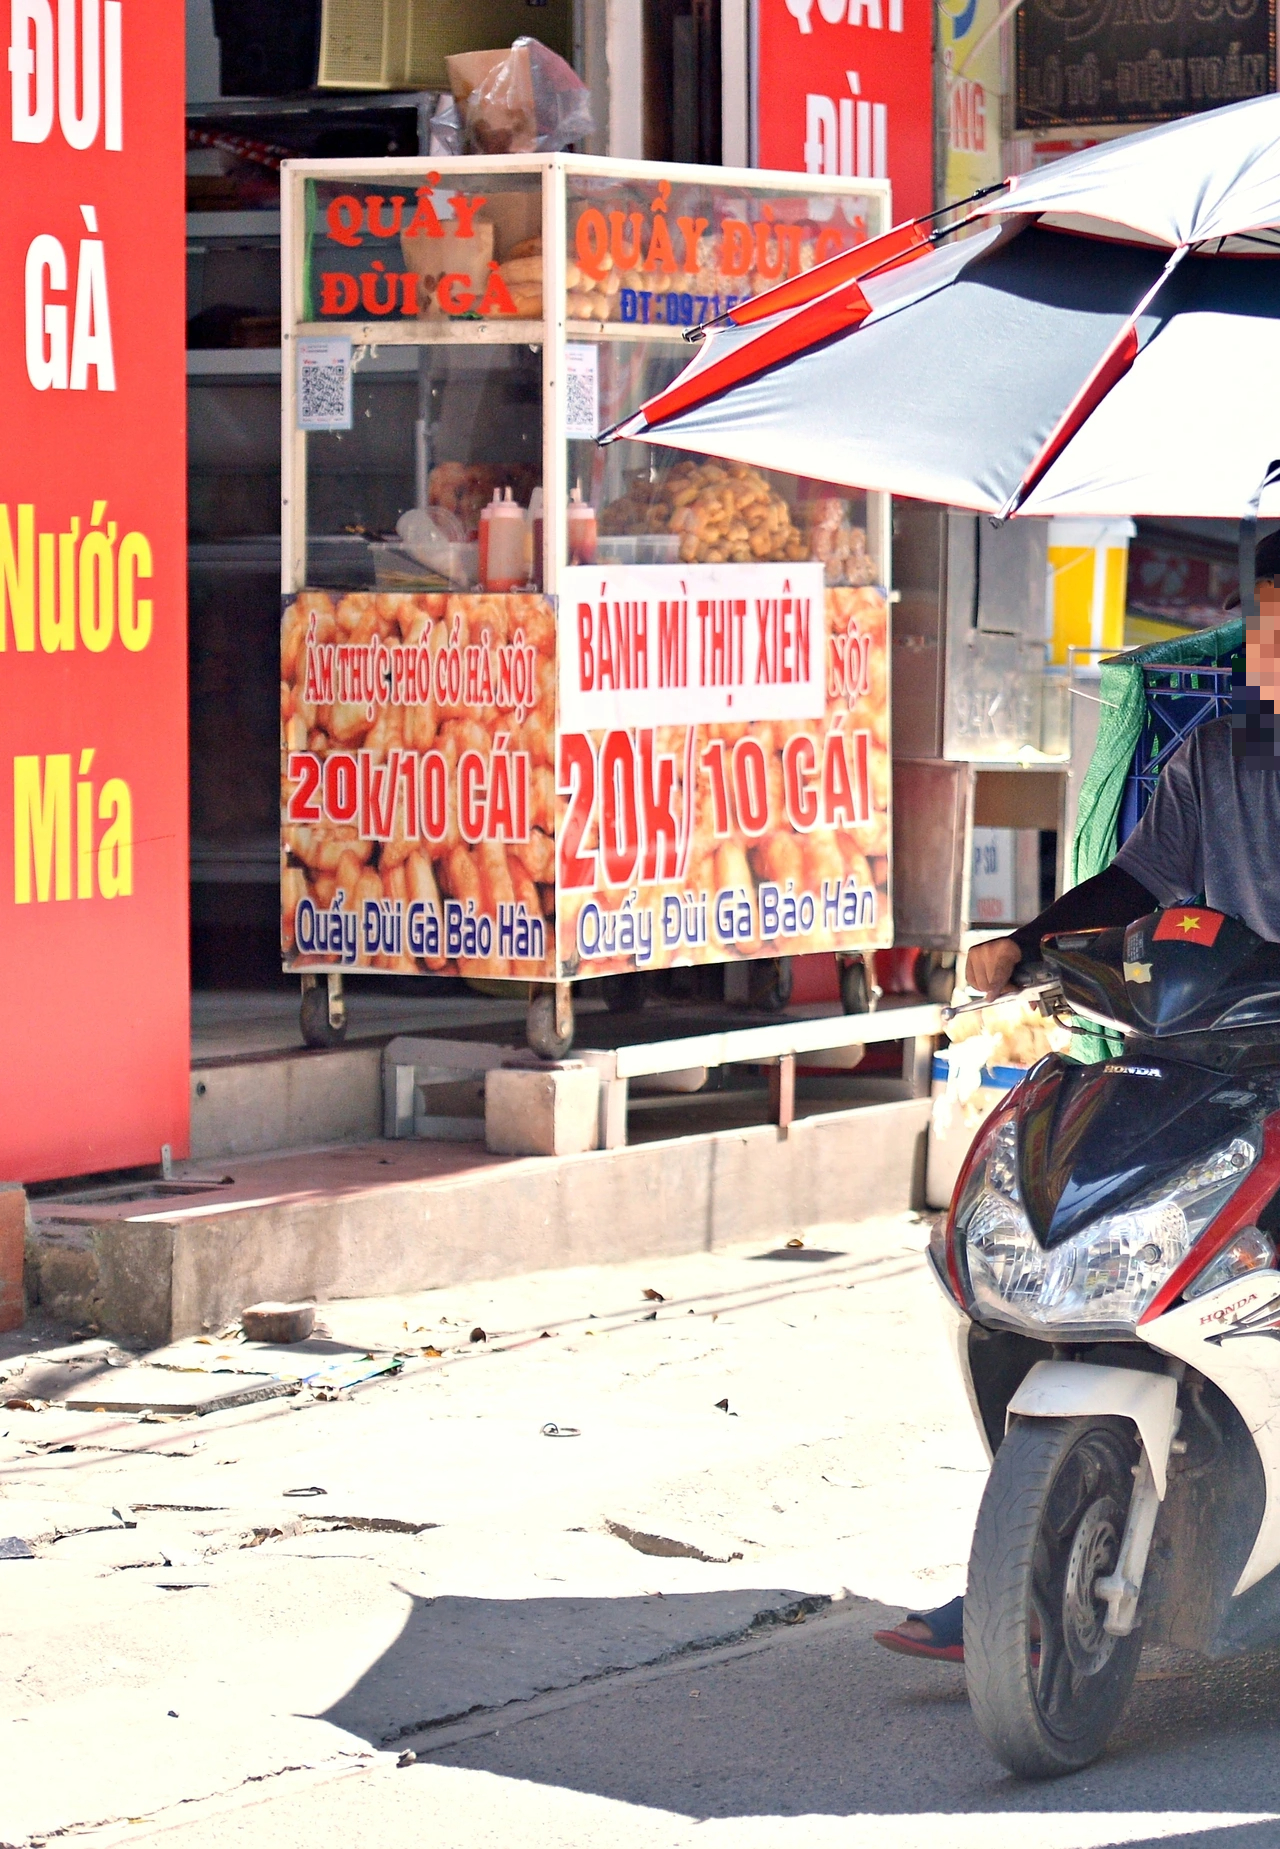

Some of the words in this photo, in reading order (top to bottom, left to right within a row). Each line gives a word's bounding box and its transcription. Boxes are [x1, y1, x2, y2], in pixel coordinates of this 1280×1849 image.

[326, 171, 487, 247] QUẨY
[575, 180, 708, 281] QUẨY
[721, 205, 803, 279] ĐÙI
[25, 205, 117, 392] GÀ
[320, 260, 431, 315] ĐÙI
[436, 260, 518, 315] GÀ
[0, 500, 152, 653] Nước
[304, 612, 334, 704] ẨM
[337, 635, 389, 722] THỰC
[391, 620, 430, 705] PHỐ
[435, 615, 461, 706] CỔ
[464, 630, 495, 706] HÀ
[498, 628, 535, 723] NỘI
[577, 581, 648, 692] BÁNH
[658, 581, 688, 688] MÌ
[697, 599, 747, 707] THỊT
[755, 578, 811, 685] XIÊN
[828, 619, 872, 709] NỘI
[457, 732, 530, 843] CÁI
[701, 738, 770, 838] 10
[784, 712, 873, 833] CÁI
[14, 748, 133, 904] Mía
[296, 892, 356, 965] Quẩy
[363, 899, 402, 956] Đùi
[407, 901, 440, 960] Gà
[445, 895, 491, 959] Bảo
[498, 903, 545, 960] Hân
[577, 891, 653, 965] Quẩy
[661, 893, 707, 950] Đùi
[716, 888, 753, 945] Gà
[760, 881, 815, 940] Bảo
[822, 874, 876, 932] Hân
[1103, 1065, 1162, 1078] HONDA
[1200, 1293, 1258, 1325] HONDA
